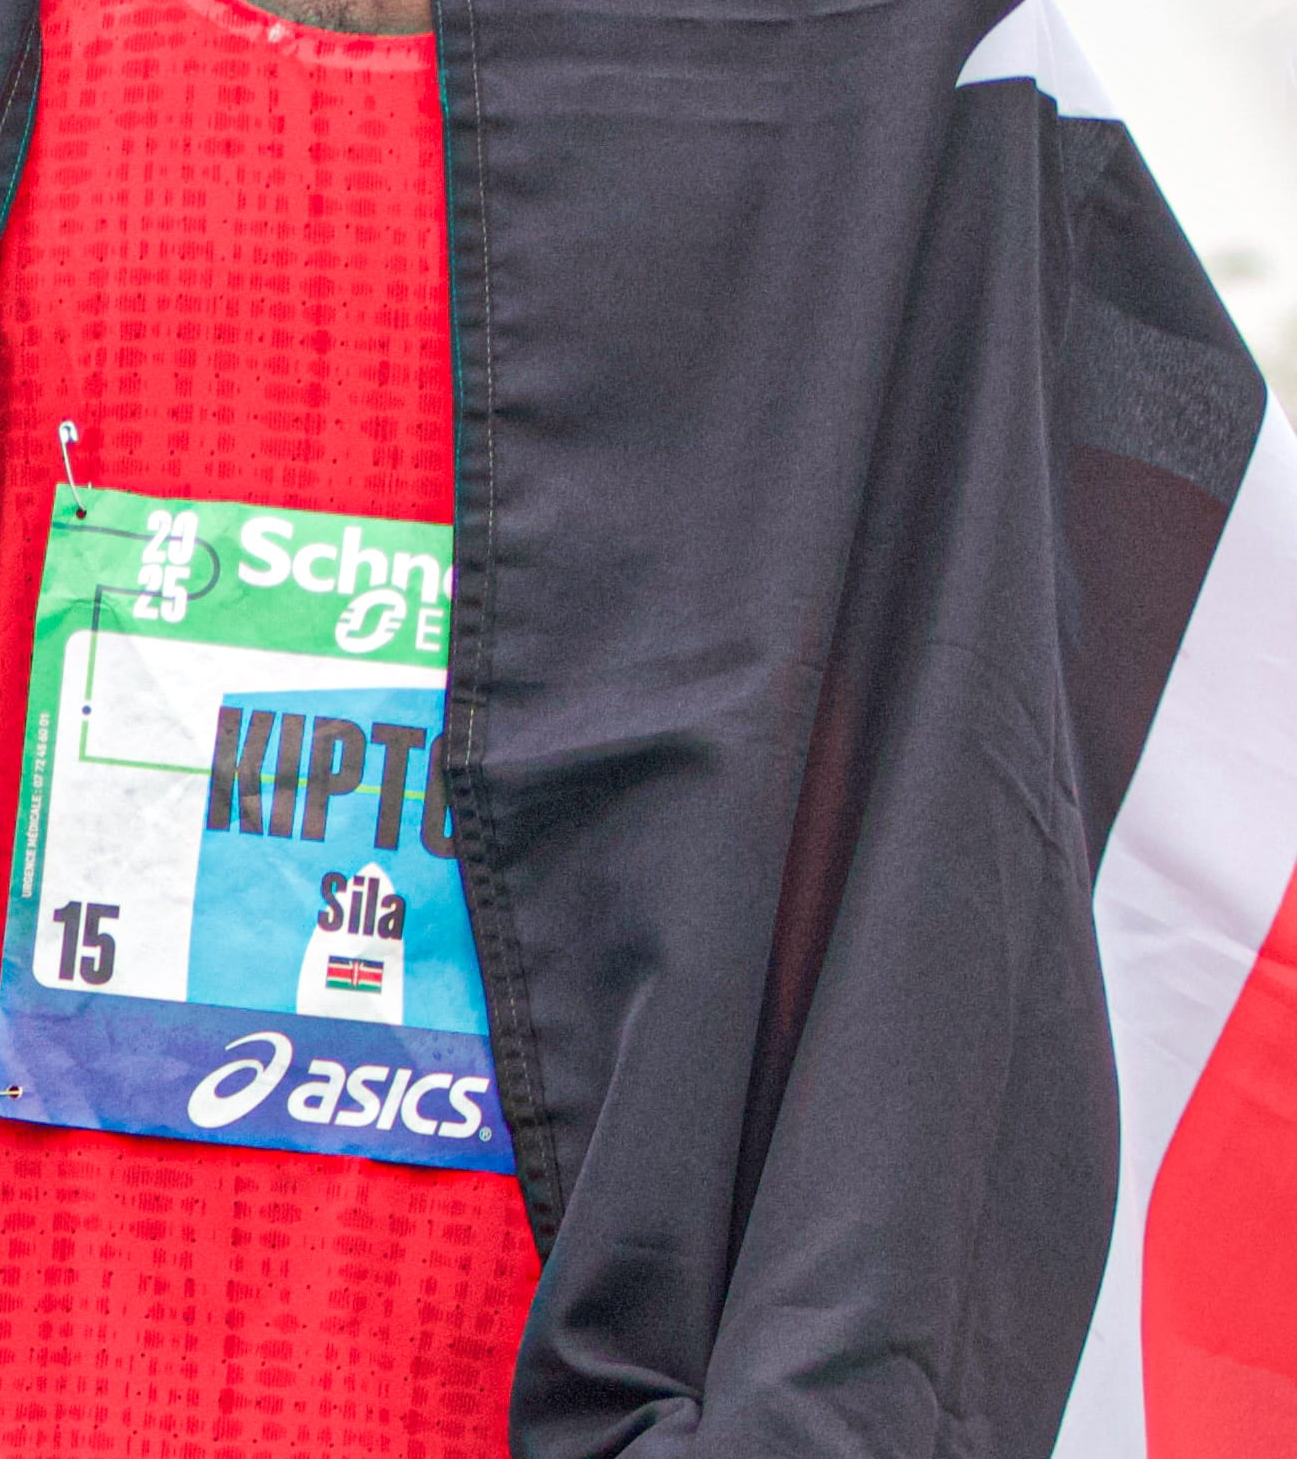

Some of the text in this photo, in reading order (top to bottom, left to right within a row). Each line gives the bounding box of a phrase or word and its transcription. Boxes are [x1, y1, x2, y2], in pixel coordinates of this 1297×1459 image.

[141, 508, 198, 564] 20
[238, 514, 453, 605] Schn
[131, 563, 192, 624] 25
[317, 871, 407, 941] Sila
[53, 900, 121, 984] 15
